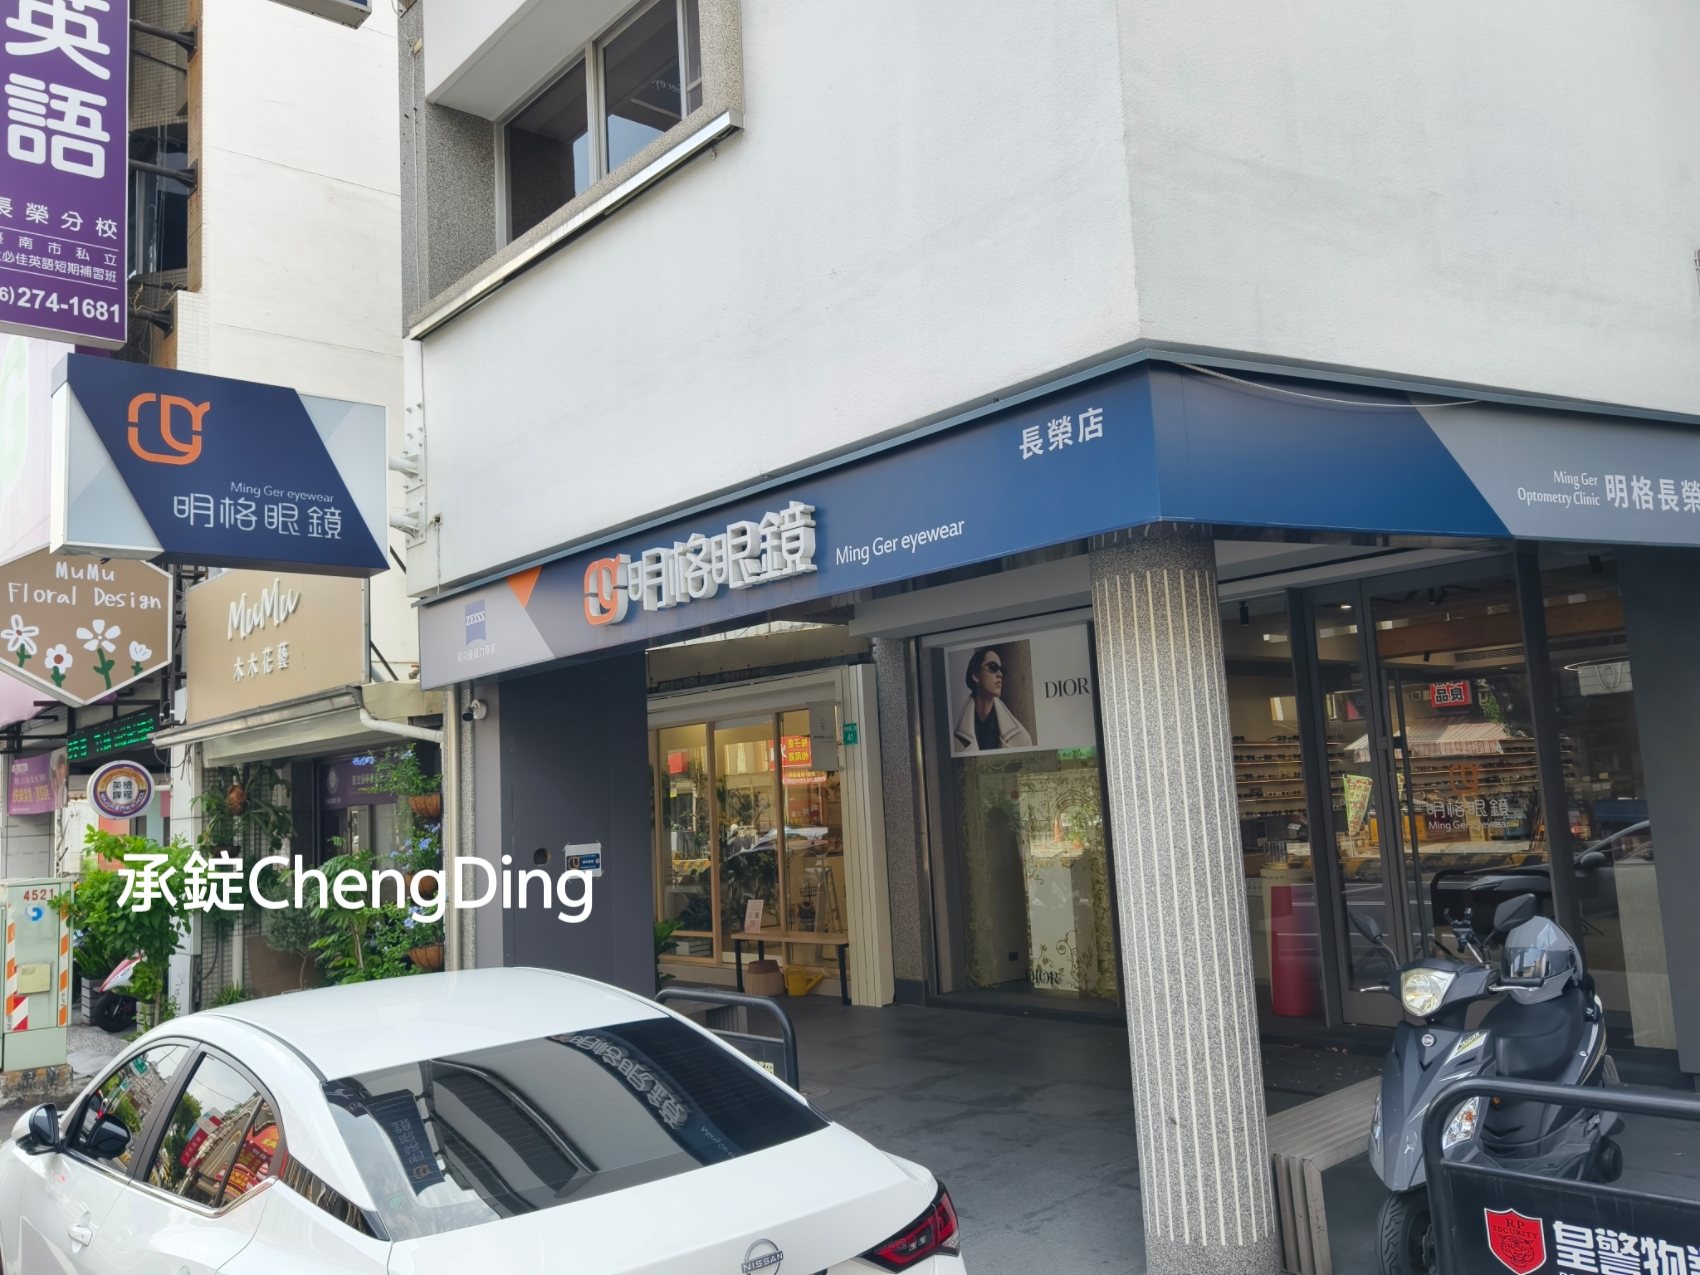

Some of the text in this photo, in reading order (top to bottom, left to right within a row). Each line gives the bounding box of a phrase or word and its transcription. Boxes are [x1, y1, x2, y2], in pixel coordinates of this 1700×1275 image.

[0, 232, 118, 267] 南市私立
[1018, 407, 1104, 460] 長榮店
[1553, 470, 1598, 489] Ming Ger
[230, 481, 335, 504] Ming Ger eyewear
[1517, 487, 1600, 509] Optometry Clinic
[173, 493, 342, 540] 明格眼鏡
[835, 520, 966, 566] Ming Ger eyewear
[627, 501, 818, 612] 明格眼鏡
[55, 560, 116, 582] MuMu
[8, 582, 162, 610] Floral Design
[233, 641, 290, 684] 木木花藝
[1043, 676, 1091, 699] DIOR
[1426, 798, 1510, 819] 明格眼鏡
[1428, 820, 1452, 831] Ming
[23, 888, 55, 901] 4521
[1492, 1225, 1538, 1240] SECURITY
[742, 1250, 784, 1273] NISSAN
